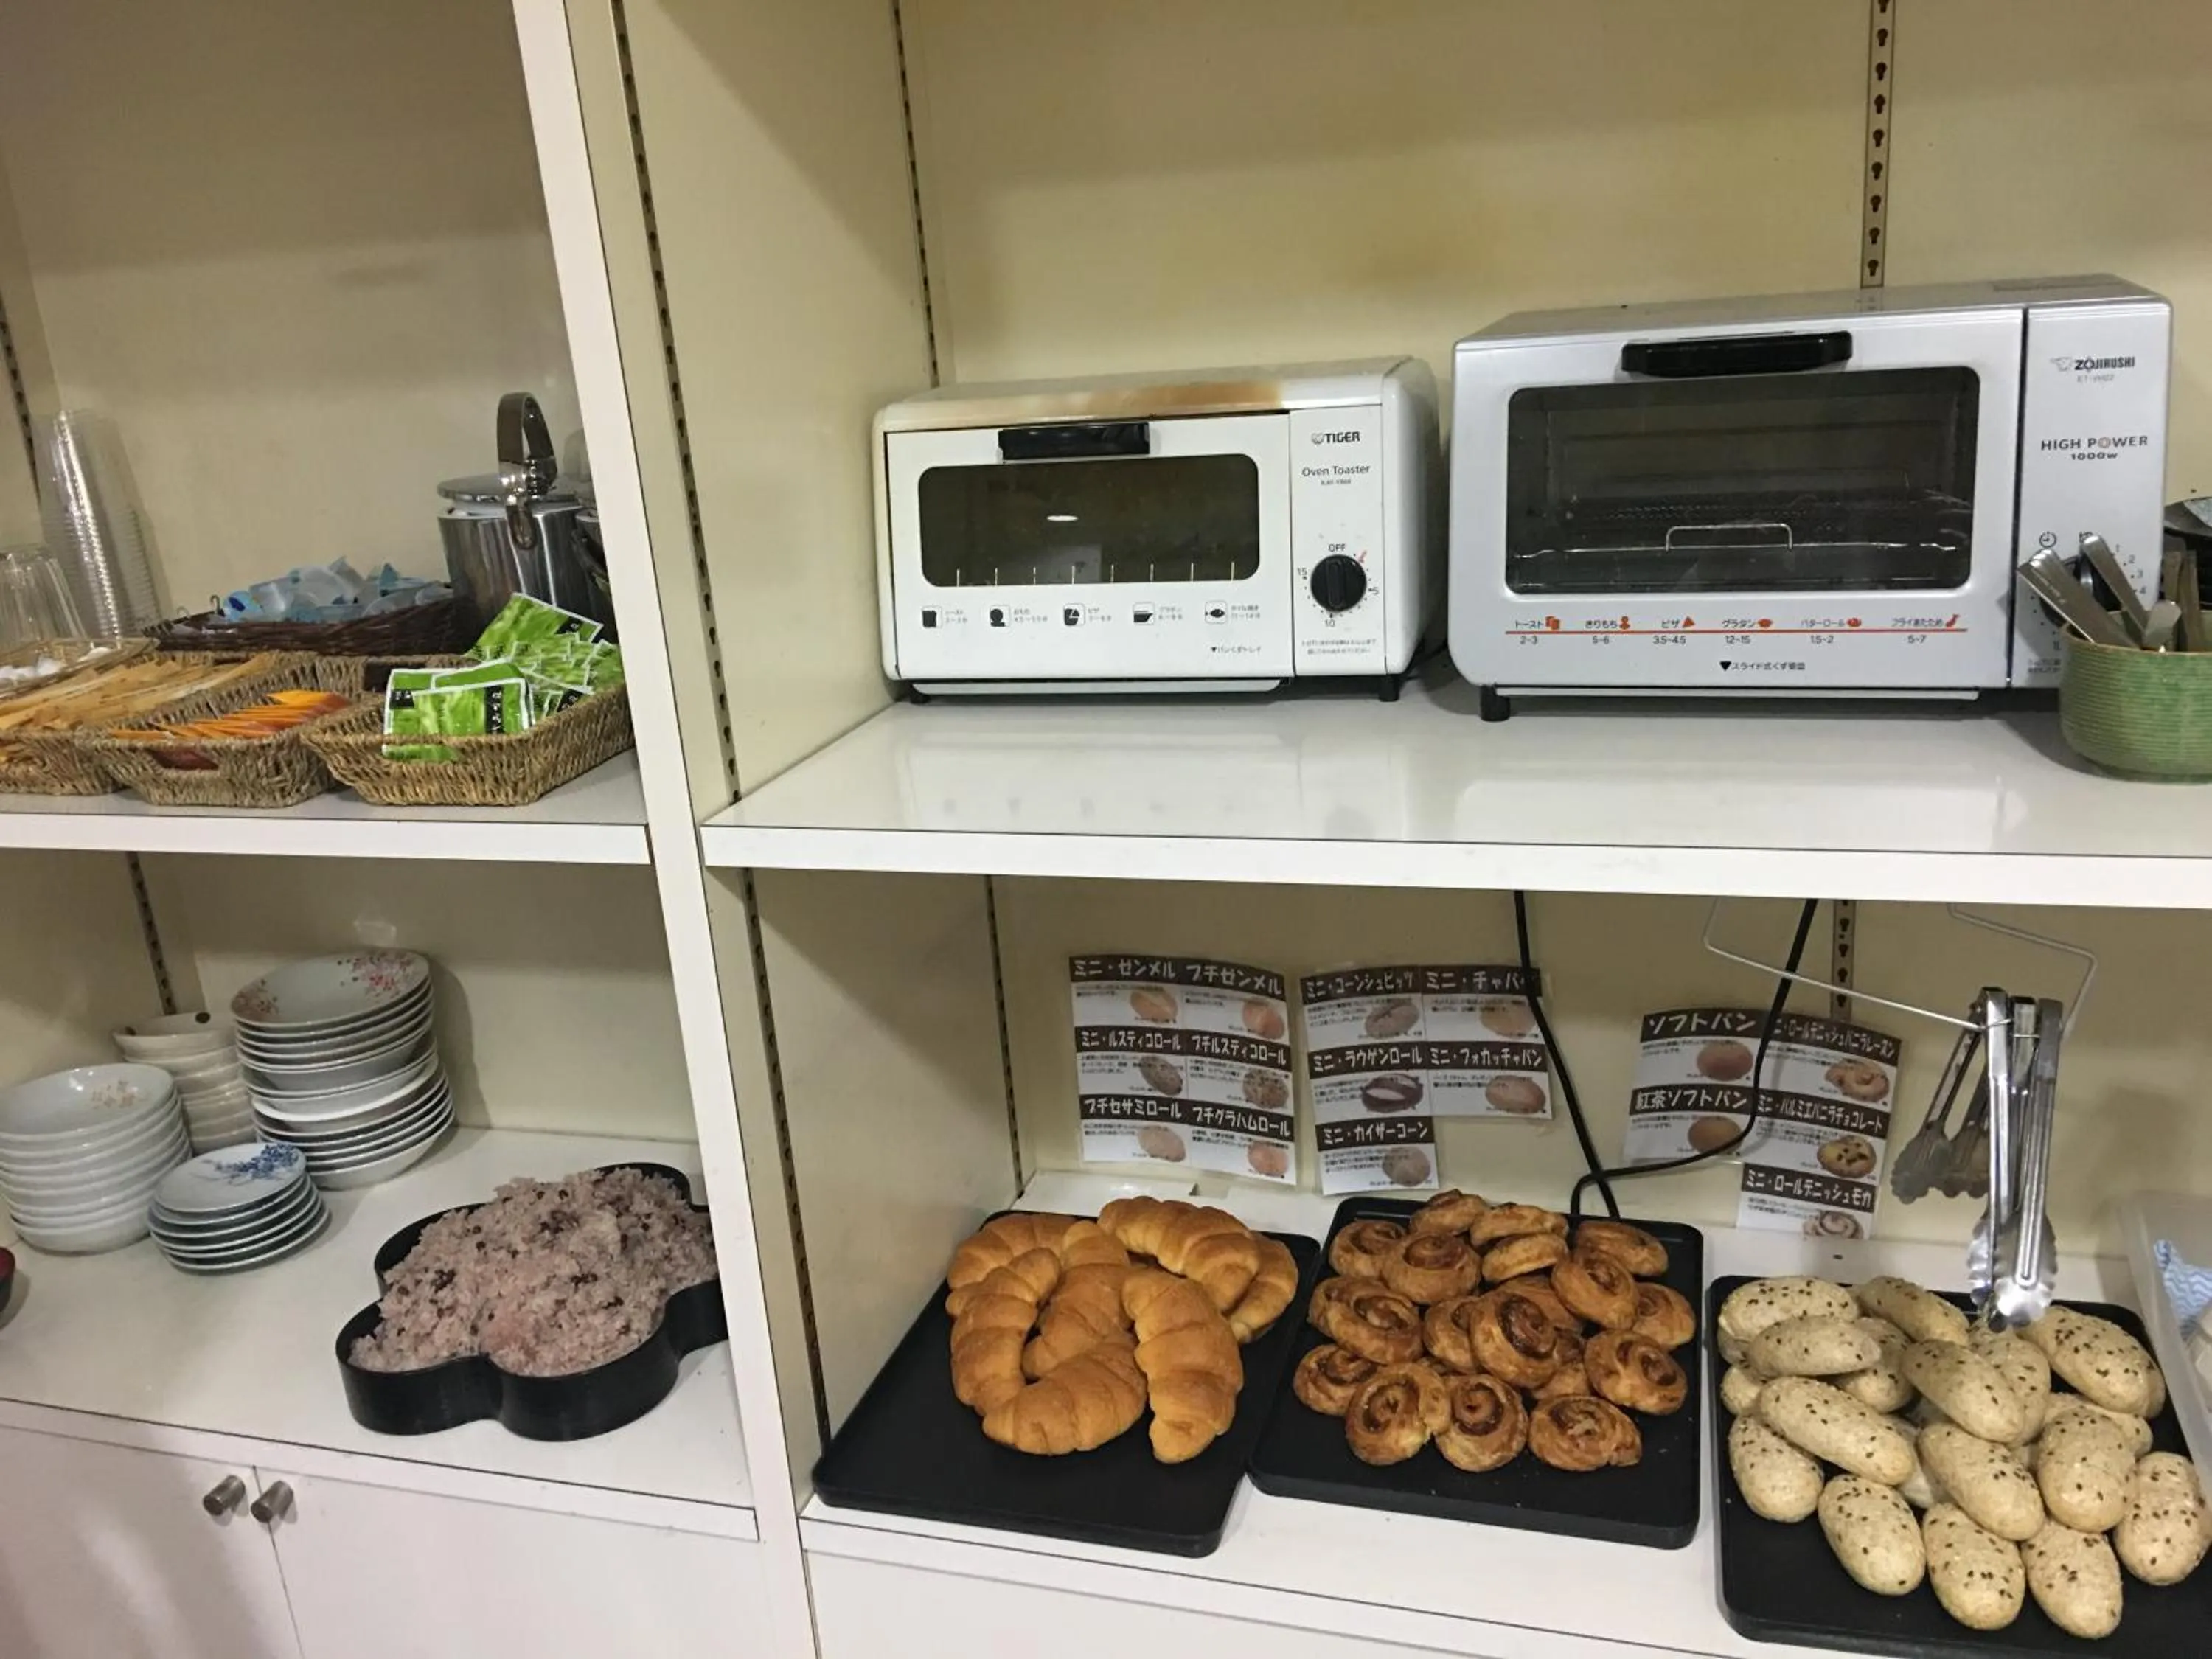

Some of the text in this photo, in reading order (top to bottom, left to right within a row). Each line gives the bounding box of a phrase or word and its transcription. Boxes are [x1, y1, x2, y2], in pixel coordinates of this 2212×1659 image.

[2073, 355, 2136, 372] ZOJIRUSHI
[1324, 431, 1360, 443] TIGER
[2040, 435, 2149, 451] HIGH POWER
[1301, 465, 1370, 477] Oven Toaster
[1327, 543, 1346, 552] OFF
[1297, 568, 1307, 576] 15
[1324, 619, 1335, 627] 10
[1514, 619, 1544, 629] トースト
[1585, 619, 1618, 629] きりもち
[1722, 619, 1756, 628] グラタン
[1084, 1097, 1182, 1119] プチセサミロール
[1192, 1106, 1291, 1137] プチグラハムロール
